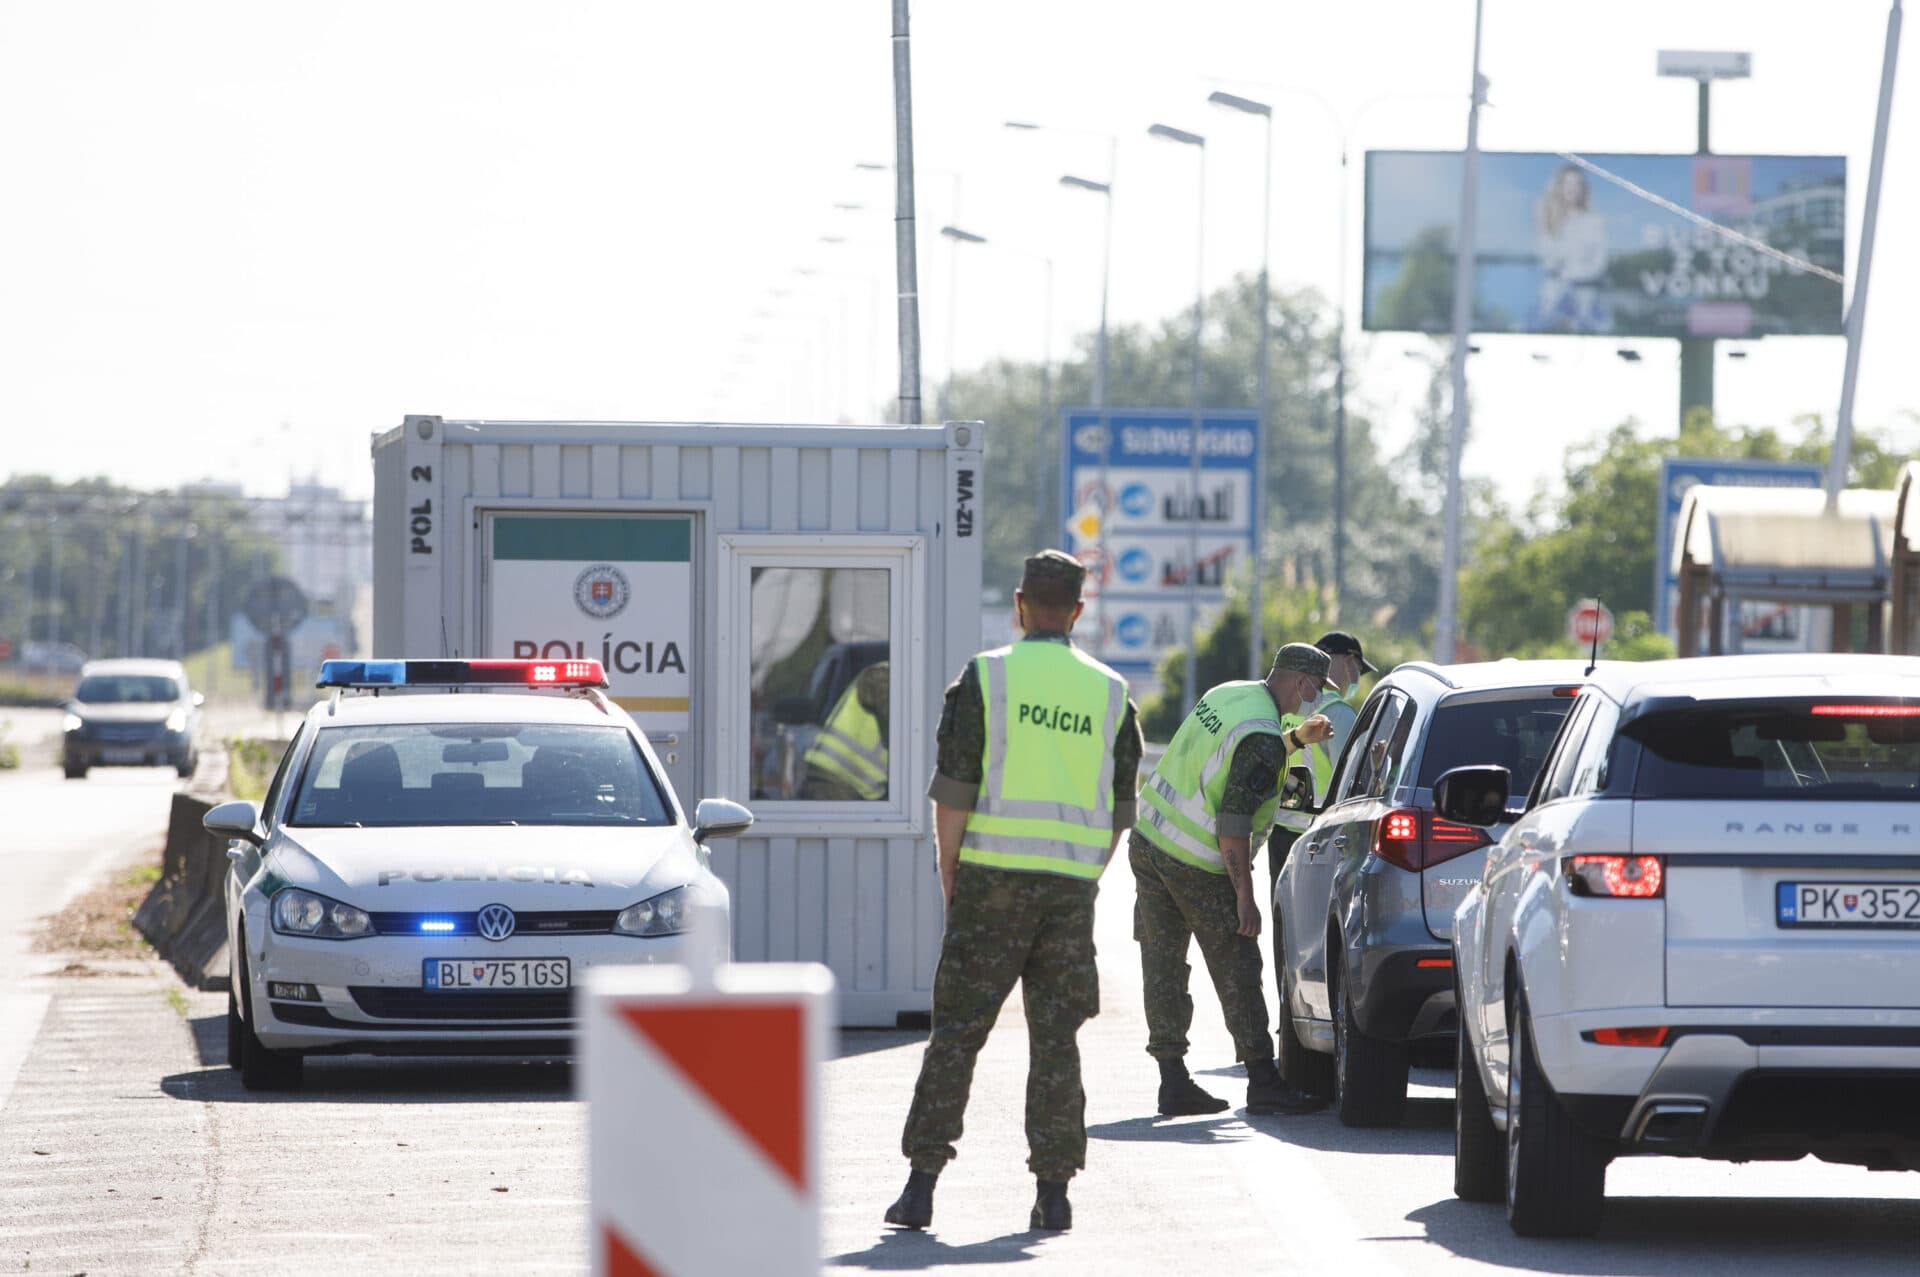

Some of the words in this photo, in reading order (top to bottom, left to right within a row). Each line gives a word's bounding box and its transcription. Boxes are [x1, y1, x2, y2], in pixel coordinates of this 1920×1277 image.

[1640, 269, 1769, 299] VONKU
[411, 465, 432, 482] 2
[411, 498, 432, 554] POL
[1019, 704, 1092, 736] POLÍCIA
[1726, 822, 1859, 834] RANGE
[1892, 823, 1920, 835] R
[1439, 878, 1481, 886] SUZUK
[1801, 888, 1841, 919] PK
[1861, 888, 1920, 919] 352
[441, 963, 471, 986] BL
[486, 963, 564, 986] 751GS
